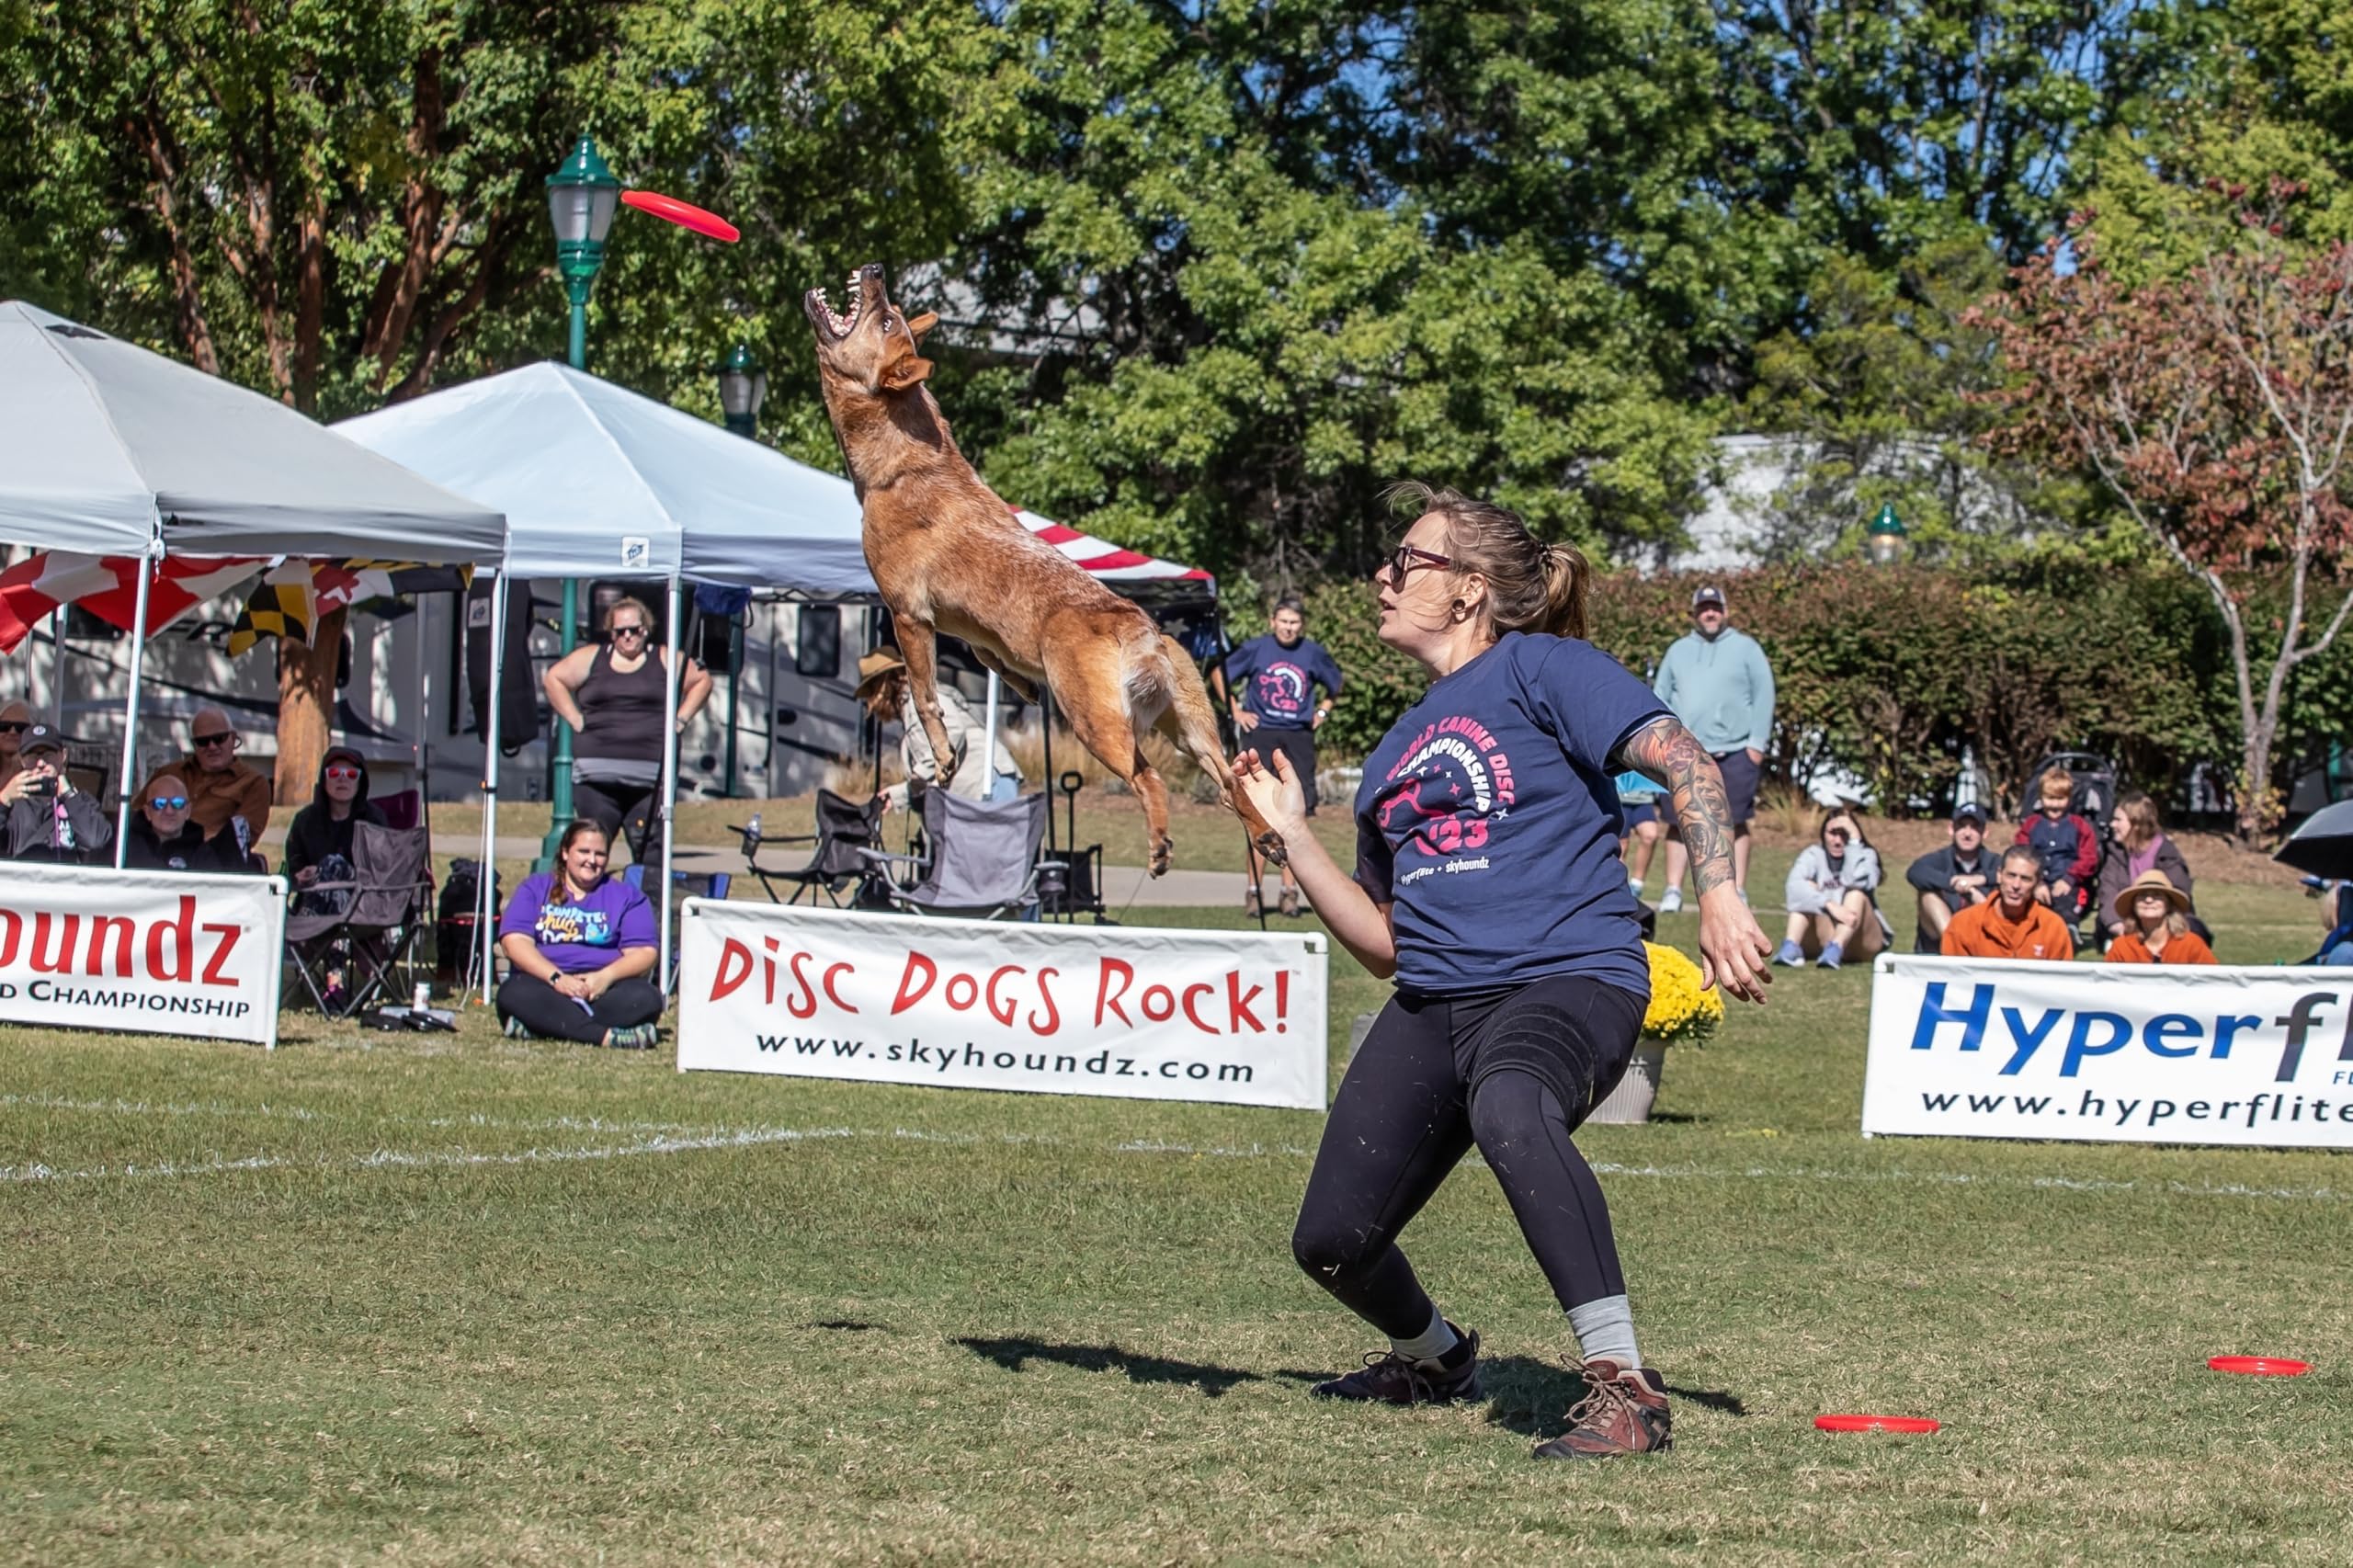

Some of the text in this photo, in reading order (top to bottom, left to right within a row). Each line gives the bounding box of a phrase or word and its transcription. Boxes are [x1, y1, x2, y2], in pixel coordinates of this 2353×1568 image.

[1397, 737, 1492, 812] CHAMPIONSHIP
[1438, 716, 1498, 753] CANINE
[1488, 753, 1516, 805] DISC
[1445, 856, 1490, 874] skyhoundz
[28, 980, 250, 1018] CHAMPIONSHIP
[756, 1035, 1254, 1083] www.skyhoundz.com
